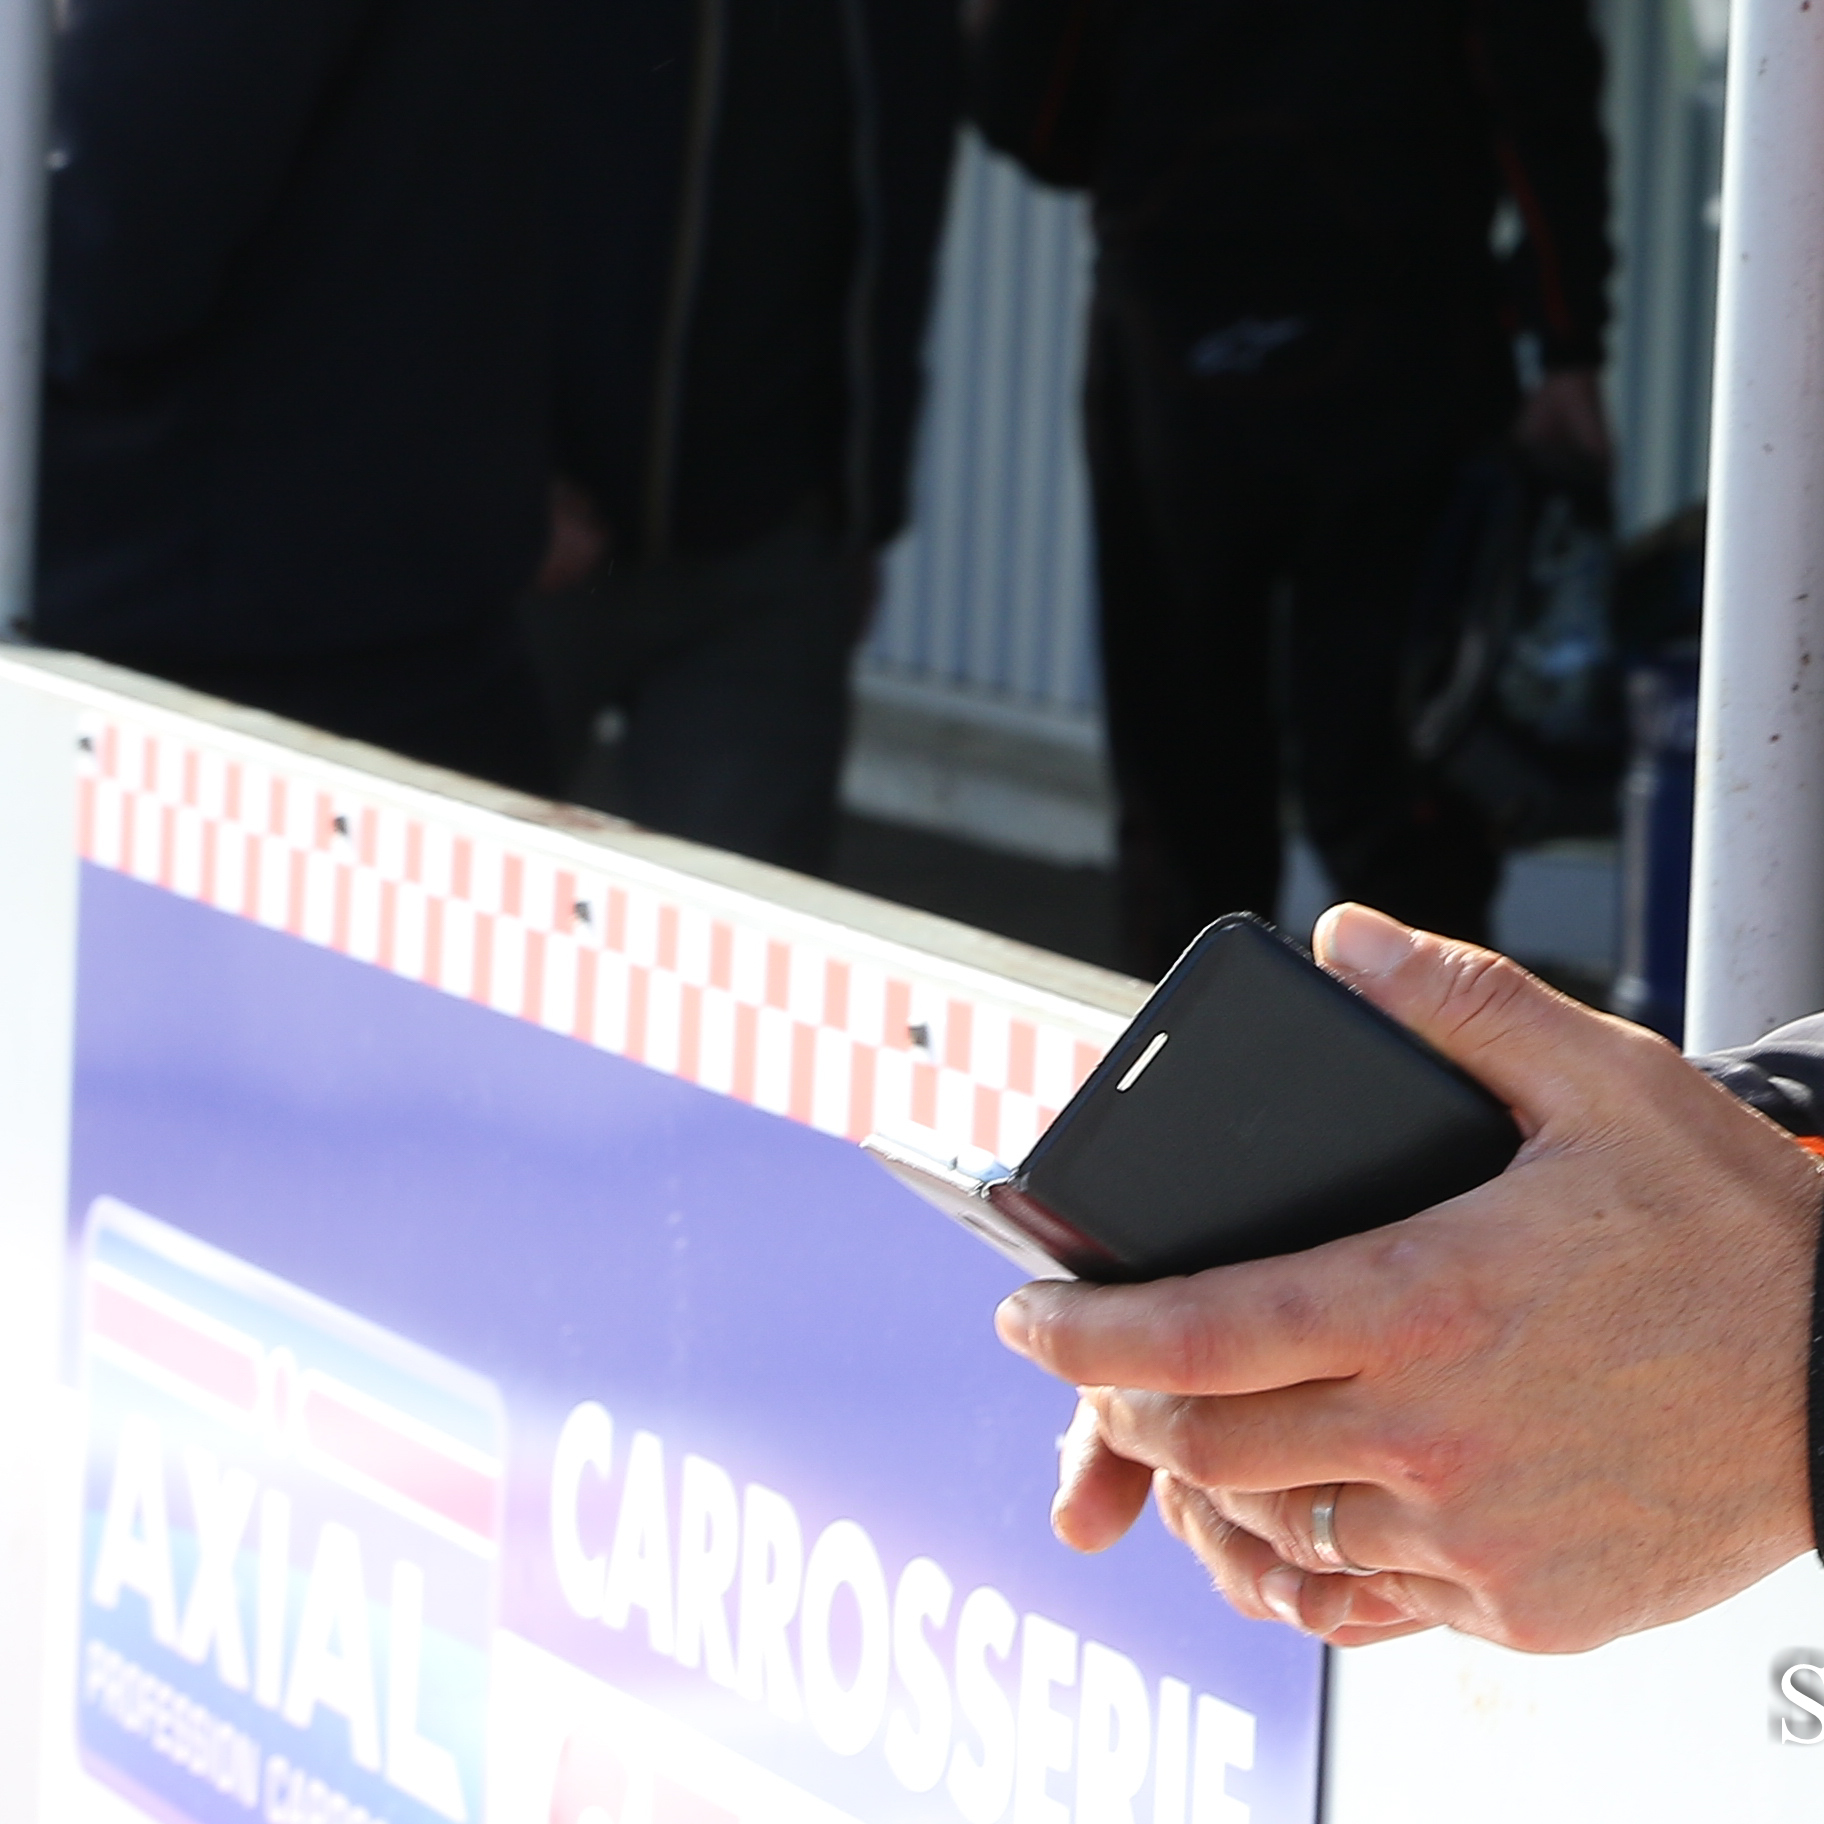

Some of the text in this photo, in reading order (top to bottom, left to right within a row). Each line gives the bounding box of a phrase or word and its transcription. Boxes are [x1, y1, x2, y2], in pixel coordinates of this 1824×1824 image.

[87, 1639, 260, 1809] PROFESSION
[91, 1413, 468, 1824] AXIAL
[551, 1401, 1256, 1824] CARROSSERIE
